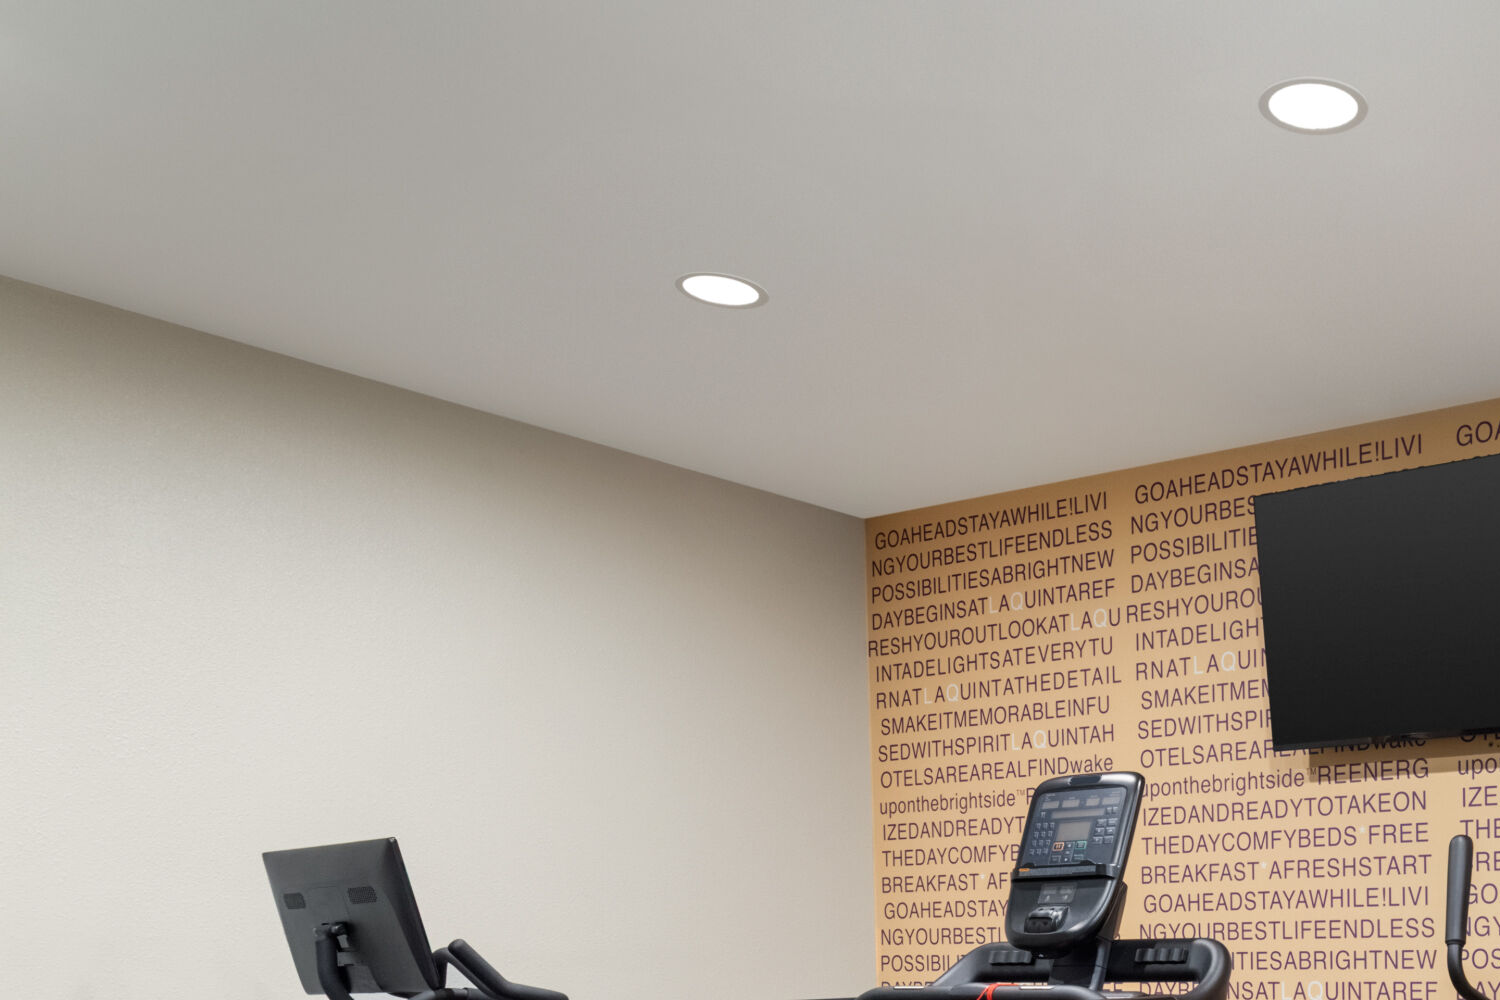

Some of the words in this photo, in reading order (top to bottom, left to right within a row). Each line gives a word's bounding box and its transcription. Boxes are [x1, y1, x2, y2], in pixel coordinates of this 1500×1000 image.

[1134, 434, 1421, 503] GOAHEADSTAYAWHILE!LIVI
[874, 491, 1106, 549] GOAHEADSTAYAWHILE!LIVI
[872, 520, 1112, 576] NGYOURBESTLIFEENDLESS
[872, 549, 1114, 604] POSSIBILITIESABRIGHTNEW
[872, 578, 1115, 630] DAYBEGINSATLAQUINTAREF
[868, 607, 1120, 657] RESHYOUROUTLOOKATLAQU
[877, 636, 1112, 682] INTADELIGHTSATEVERYTU
[876, 665, 1122, 709] RNATLAQUINTATHEDETAIL
[881, 695, 1109, 735] SMAKEITMEMORABLEINFU
[879, 723, 1113, 762] SEDWITHSPIRITLAQUINTAH
[881, 753, 1113, 788] OTELSAREAREALFINDwake
[883, 815, 1025, 841] IZEDANDREADYT
[1143, 790, 1426, 826] IZEDANDREADYTOTAKEON
[1143, 886, 1427, 913] GOAHEADSTAYAWHILE!LIVI
